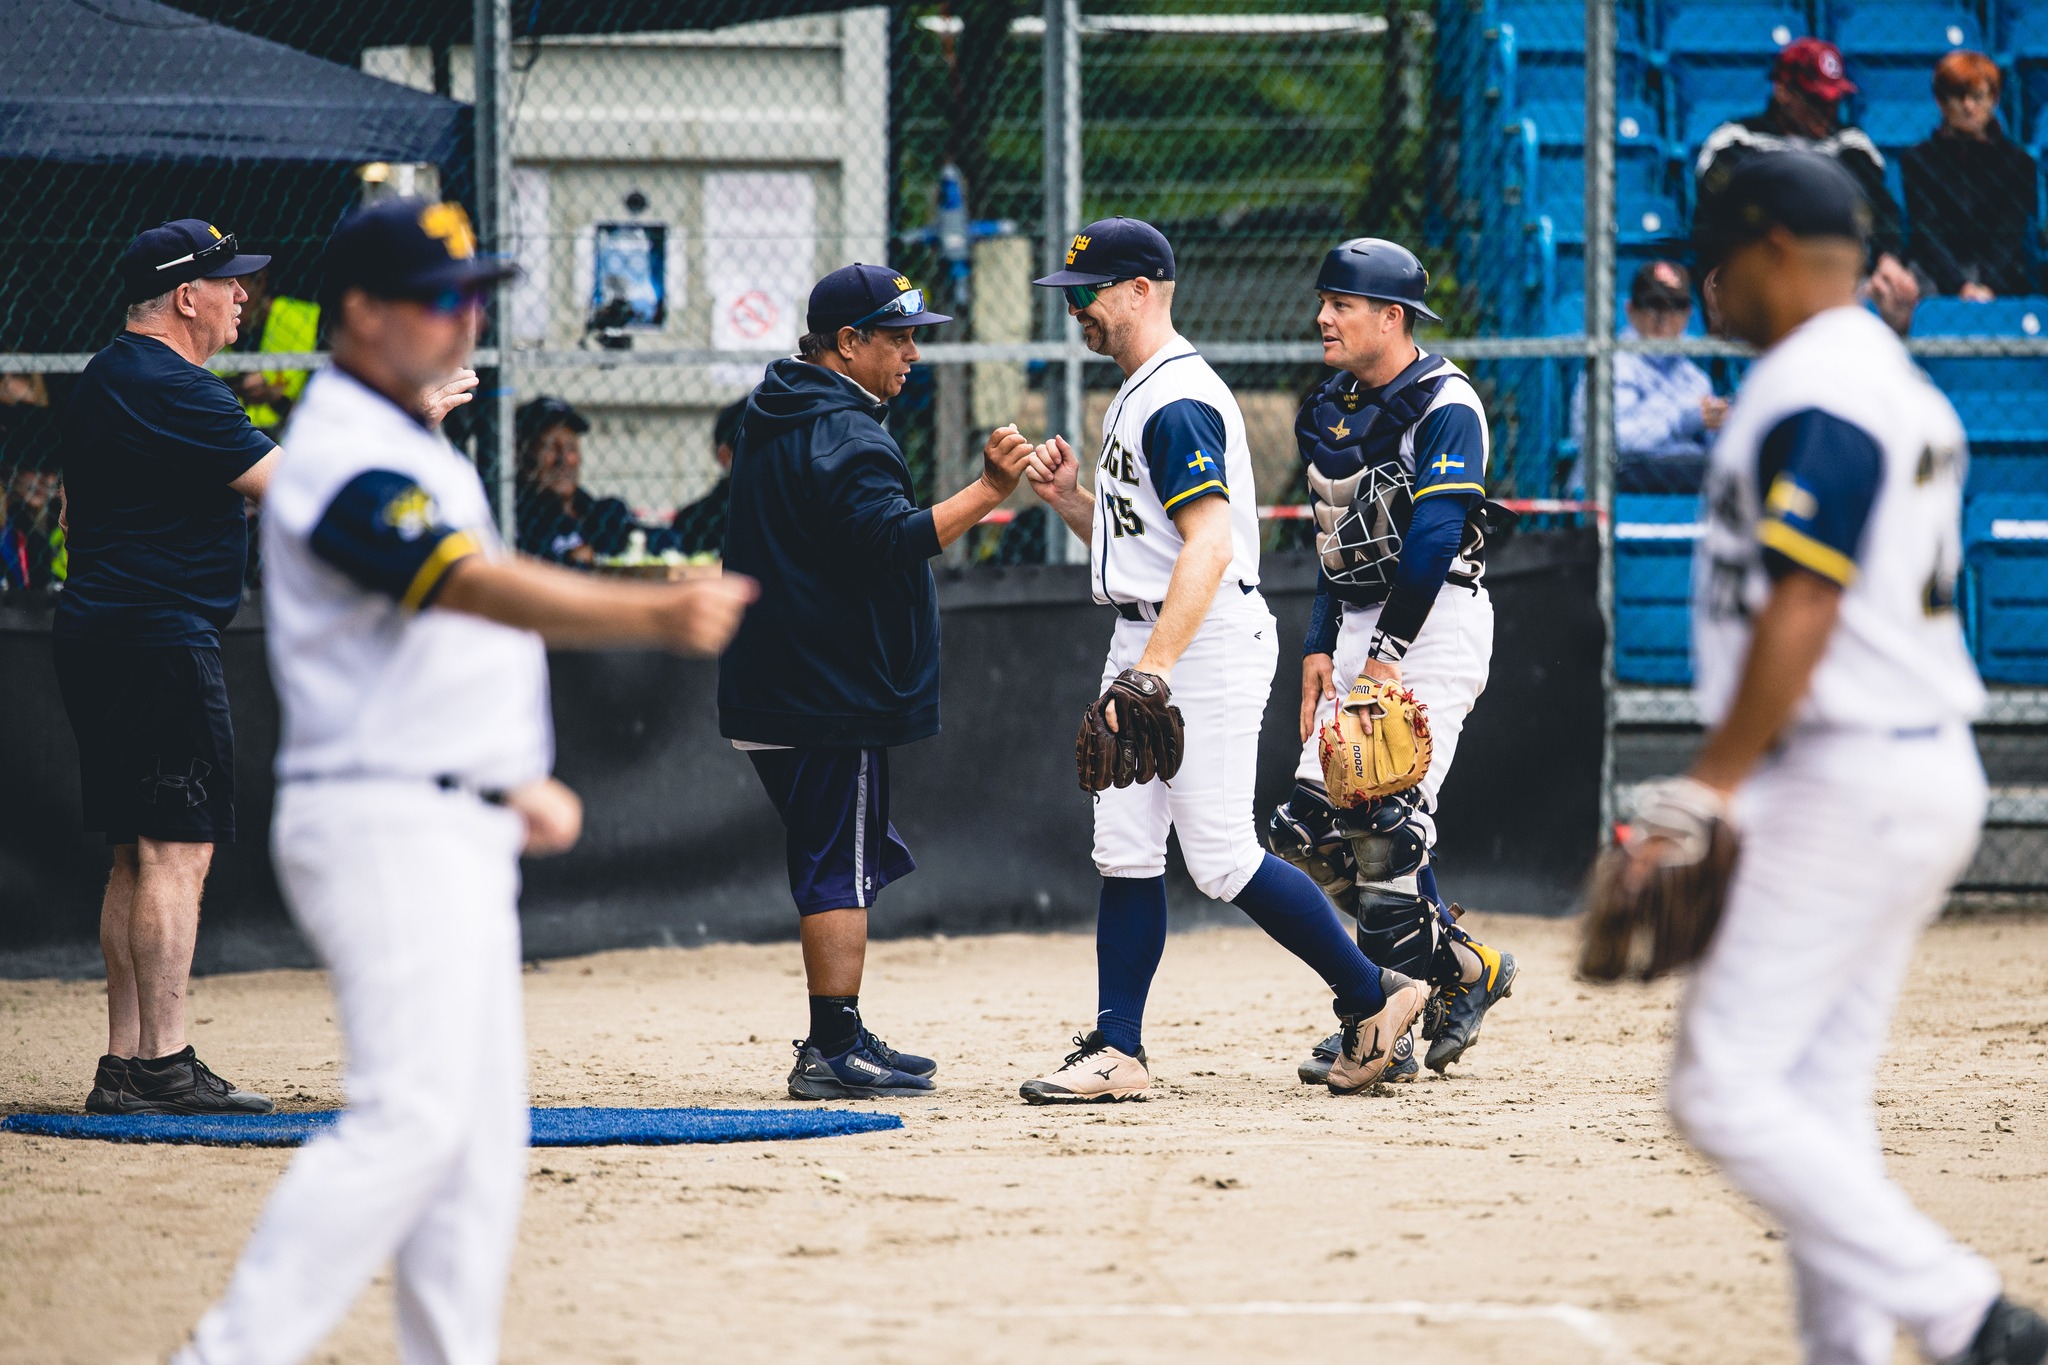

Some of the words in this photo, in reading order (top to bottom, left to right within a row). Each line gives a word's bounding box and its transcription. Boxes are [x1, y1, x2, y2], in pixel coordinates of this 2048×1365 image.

[1098, 432, 1139, 487] IGE
[1353, 745, 1363, 778] A2000
[853, 1057, 882, 1076] PUMA
